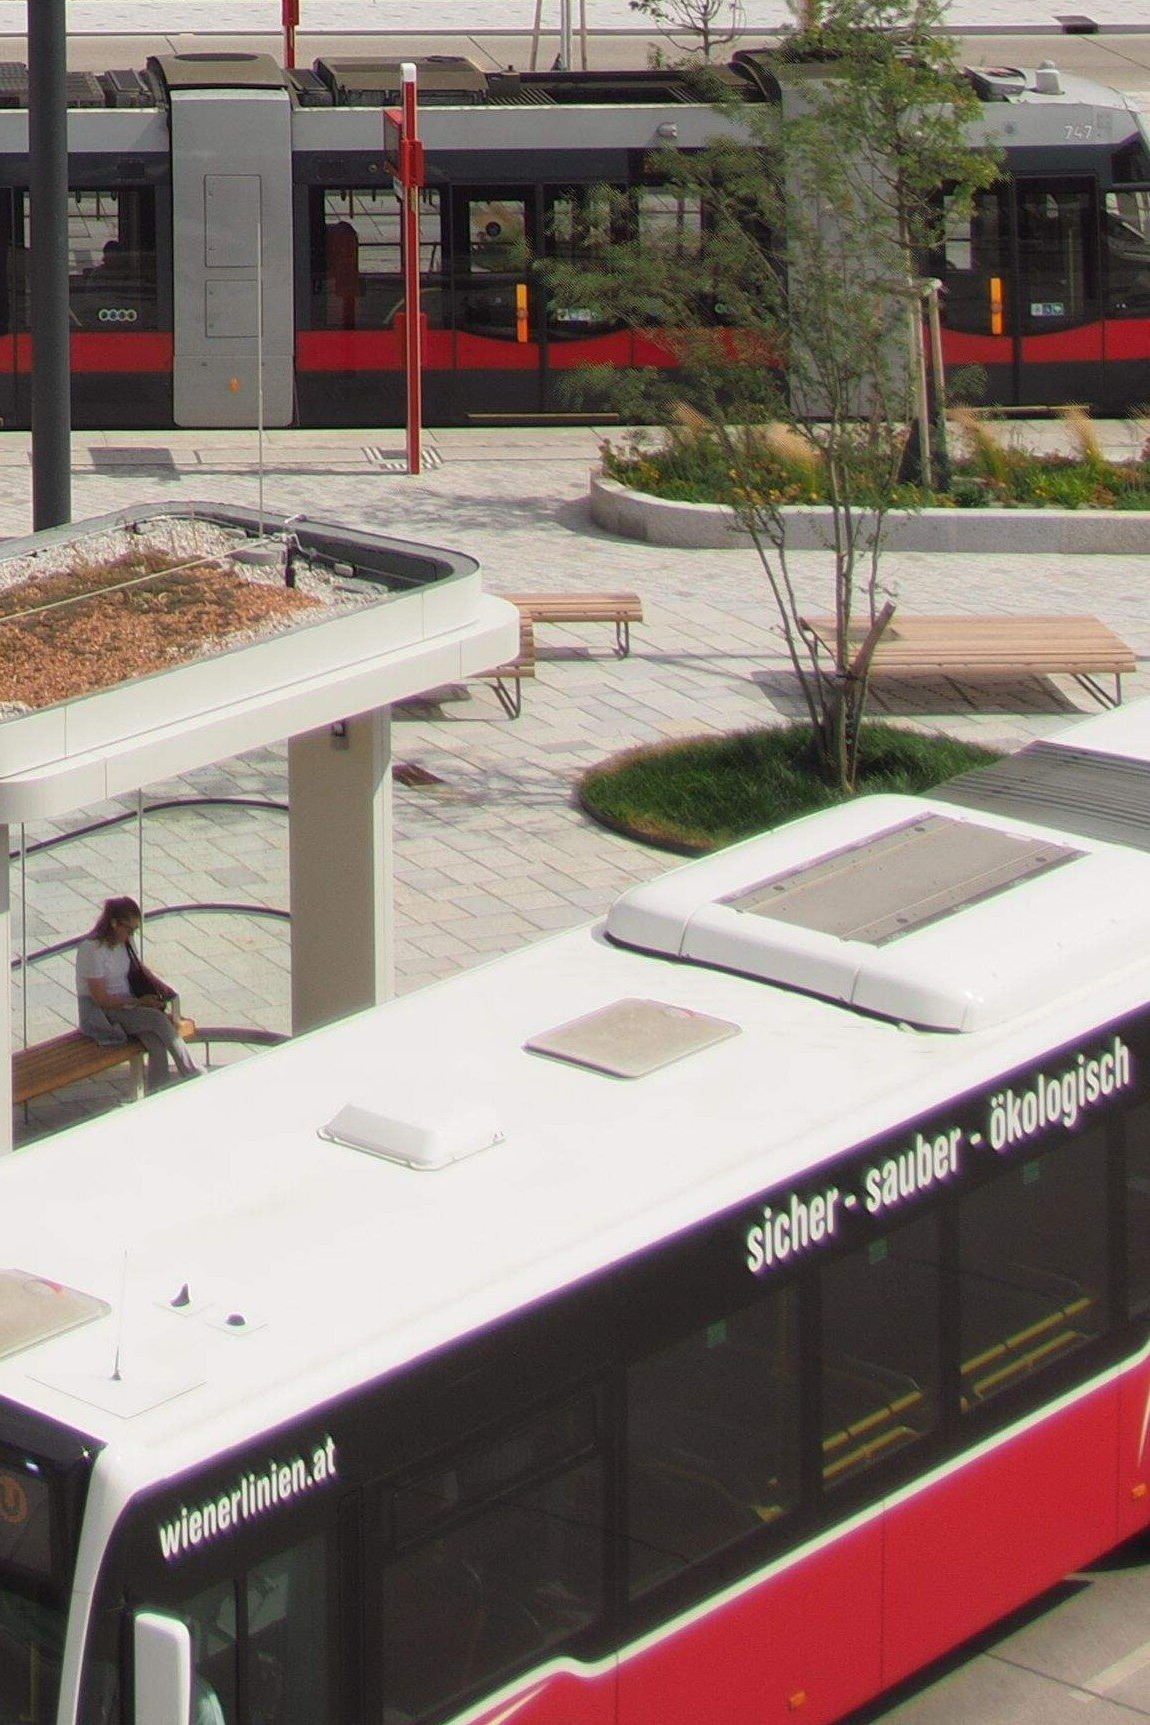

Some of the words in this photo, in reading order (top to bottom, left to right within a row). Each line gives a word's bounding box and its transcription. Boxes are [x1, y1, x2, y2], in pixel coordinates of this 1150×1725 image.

[1065, 125, 1092, 140] 747
[746, 1185, 840, 1273] sicher
[865, 1126, 962, 1214] sauber
[990, 1035, 1131, 1151] ökologisch
[159, 1434, 337, 1560] wienerlinien.at
